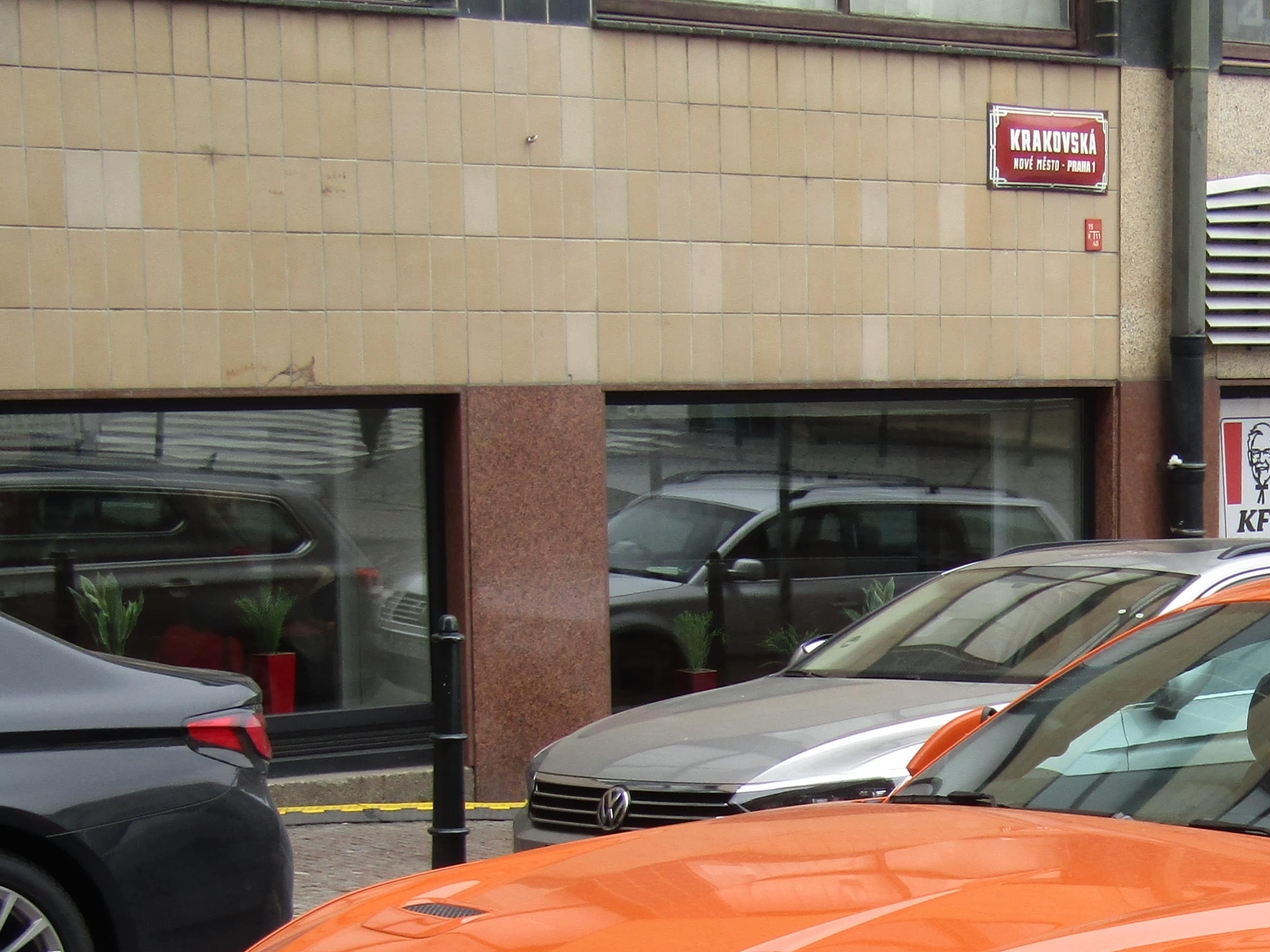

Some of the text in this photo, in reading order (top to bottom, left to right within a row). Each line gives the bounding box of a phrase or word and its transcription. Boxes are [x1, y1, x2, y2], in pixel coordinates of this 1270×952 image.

[1009, 128, 1097, 155] KRAKOVSKÁ
[1013, 155, 1034, 170] NOVÉ
[1036, 155, 1060, 171] MĚSTO
[1066, 159, 1091, 173] PRAHA
[1091, 161, 1096, 174] 1
